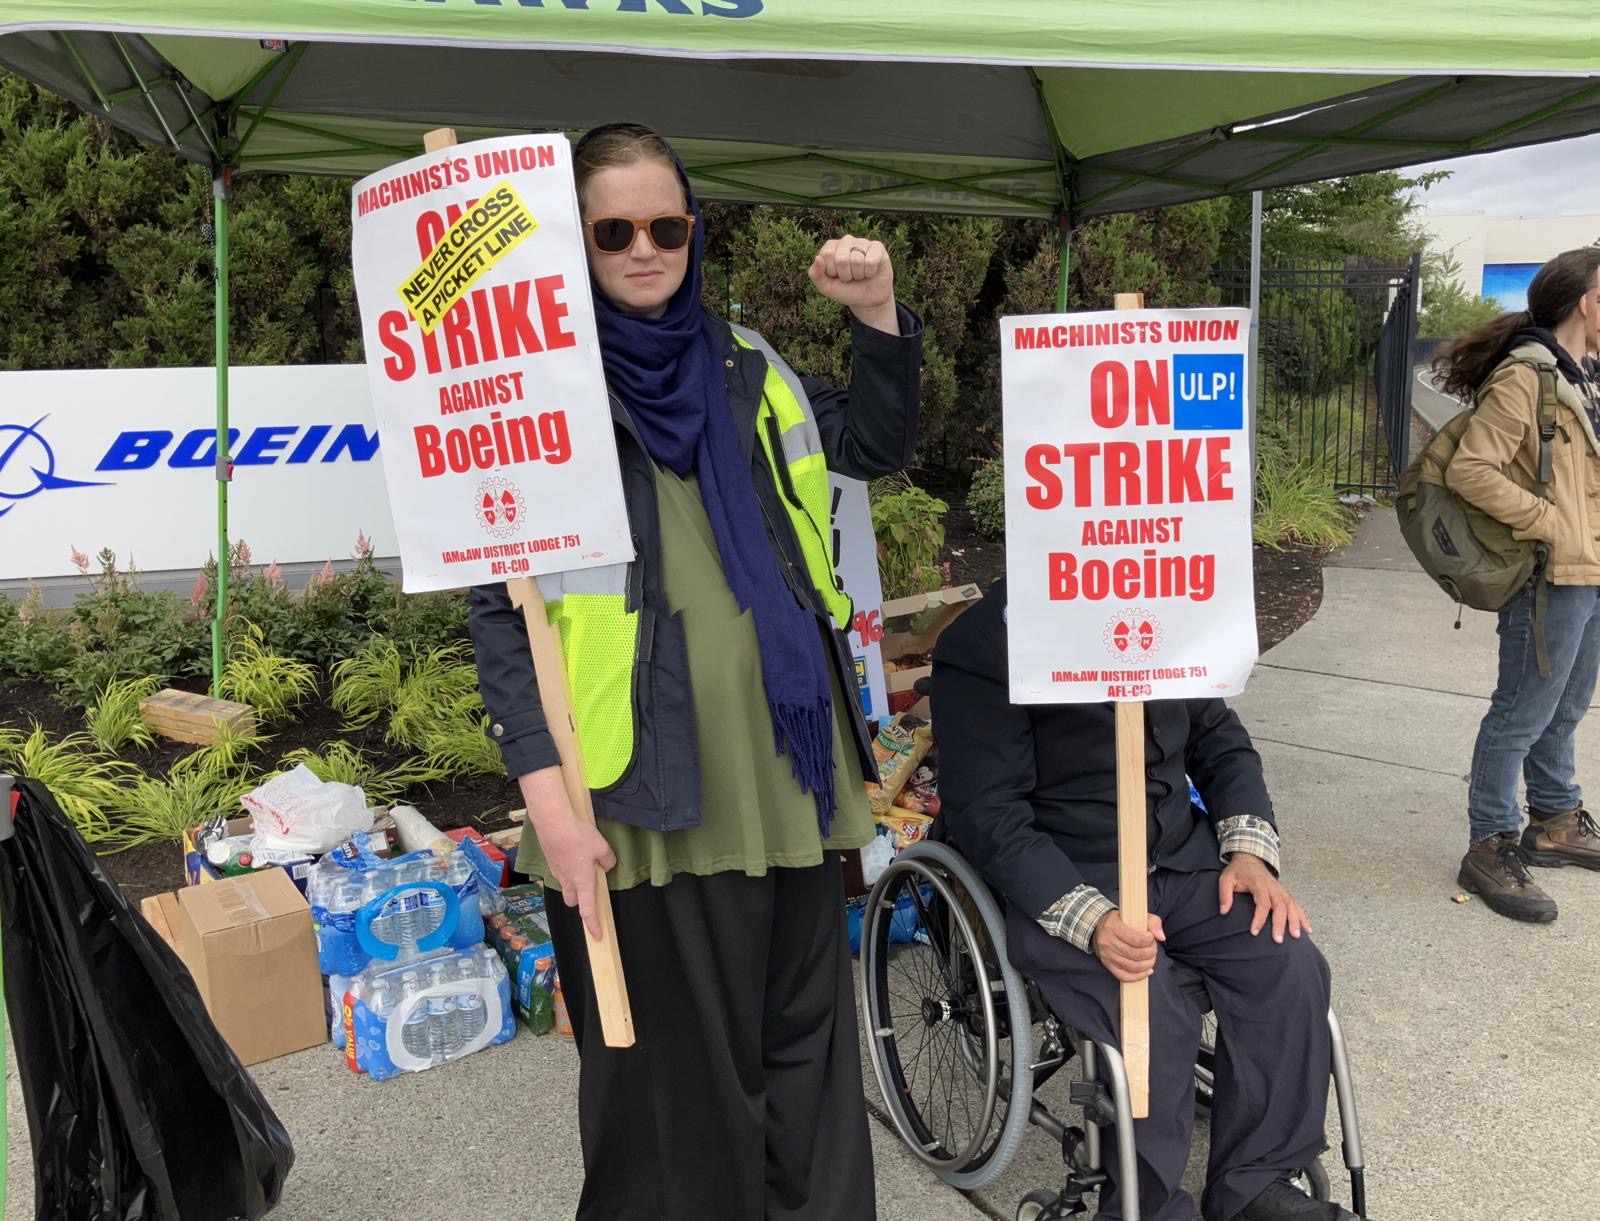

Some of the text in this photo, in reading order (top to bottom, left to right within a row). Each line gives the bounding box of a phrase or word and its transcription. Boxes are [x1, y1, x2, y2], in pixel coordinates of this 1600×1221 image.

[357, 145, 556, 217] MACHINISTS UNION
[402, 188, 514, 304] NEVER CROSS
[422, 212, 532, 327] A PICKET LINE
[1014, 319, 1240, 350] MACHINISTS UNION
[439, 371, 524, 416] AGAINST
[1090, 358, 1171, 430] ON
[1180, 372, 1236, 401] ULP!
[96, 423, 380, 472] BOEIN
[413, 409, 573, 479] Boeing
[1024, 436, 1235, 511] STRIKE
[442, 534, 581, 565] IAM&AW DISTRICT LODGE 751
[1081, 516, 1184, 547] AGAINST
[491, 558, 530, 576] AFL-CIO
[1047, 549, 1216, 603] Boeing
[1051, 665, 1208, 683] IAM&AW DISTRICT LODGE 751
